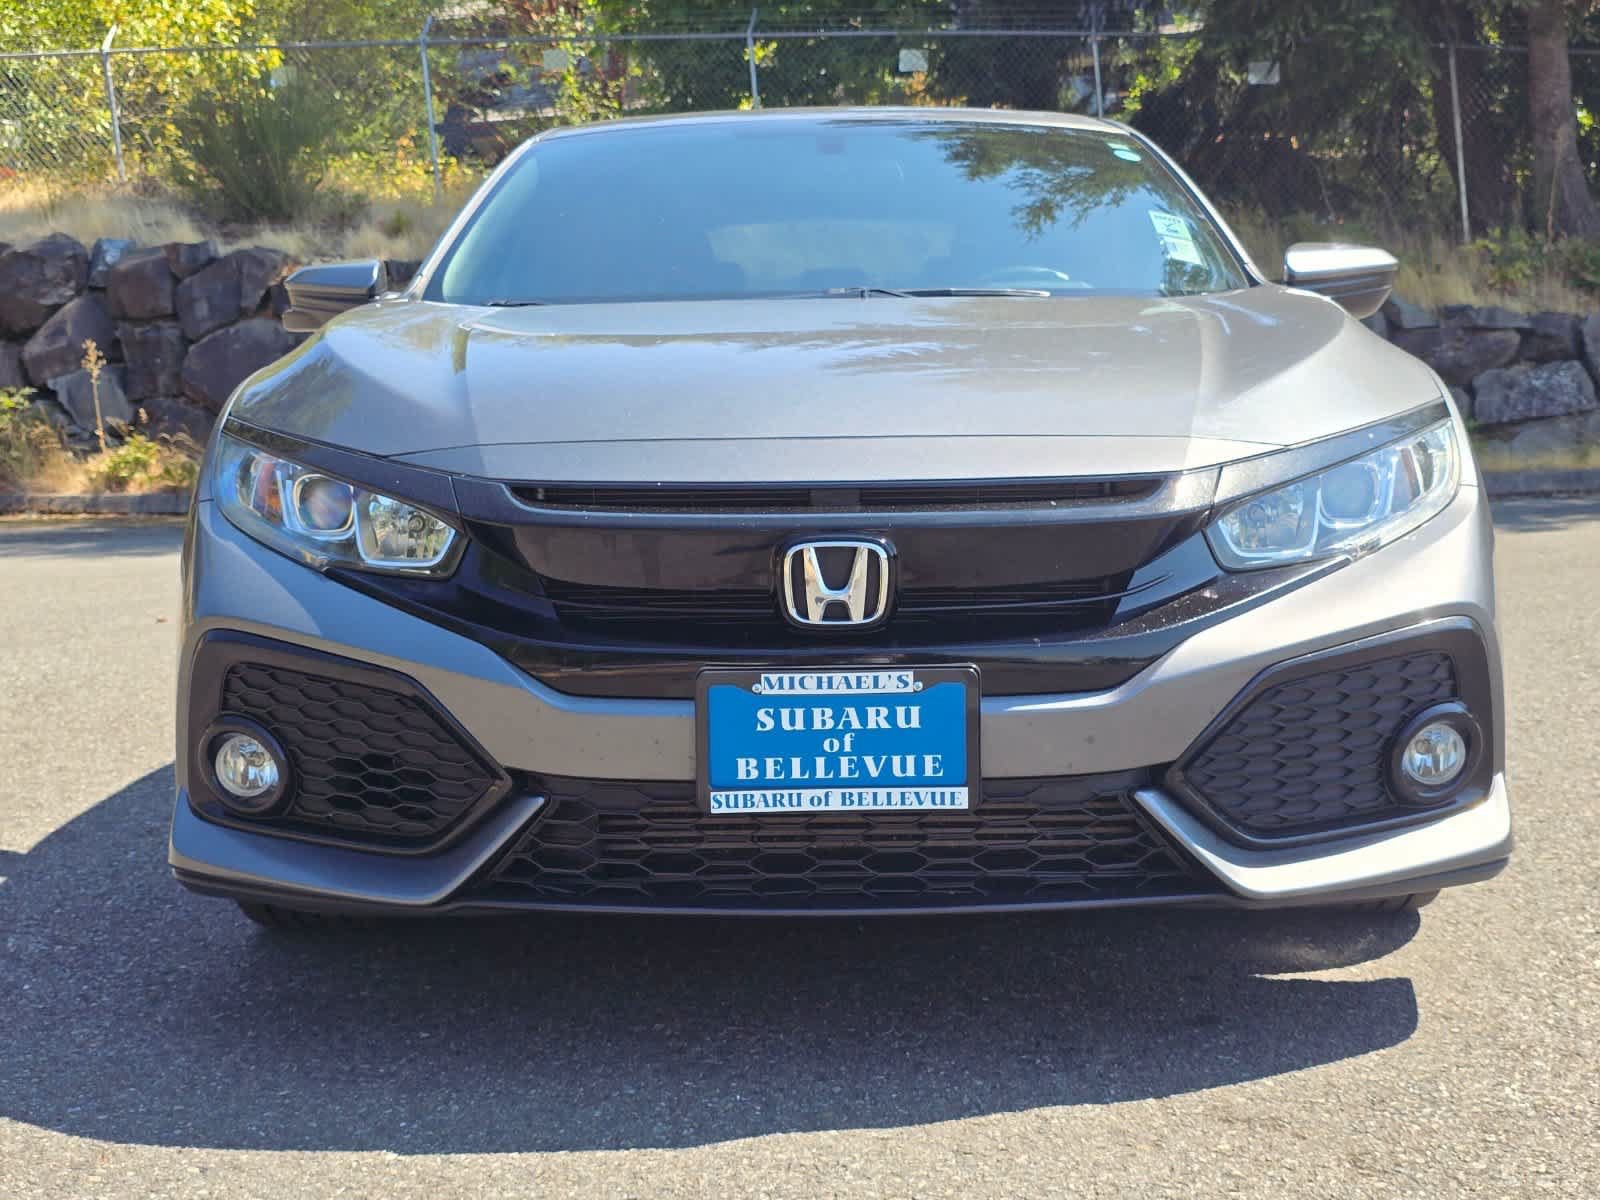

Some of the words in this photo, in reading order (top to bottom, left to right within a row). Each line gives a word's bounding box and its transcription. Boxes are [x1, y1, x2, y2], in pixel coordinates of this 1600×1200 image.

[762, 673, 911, 691] MICHAEL'S
[756, 705, 921, 732] SUBARU
[823, 733, 855, 752] of
[736, 754, 944, 780] BELLEVUE
[711, 791, 801, 810] SUBARU
[809, 791, 833, 807] of
[840, 790, 963, 807] BELLEVUE
